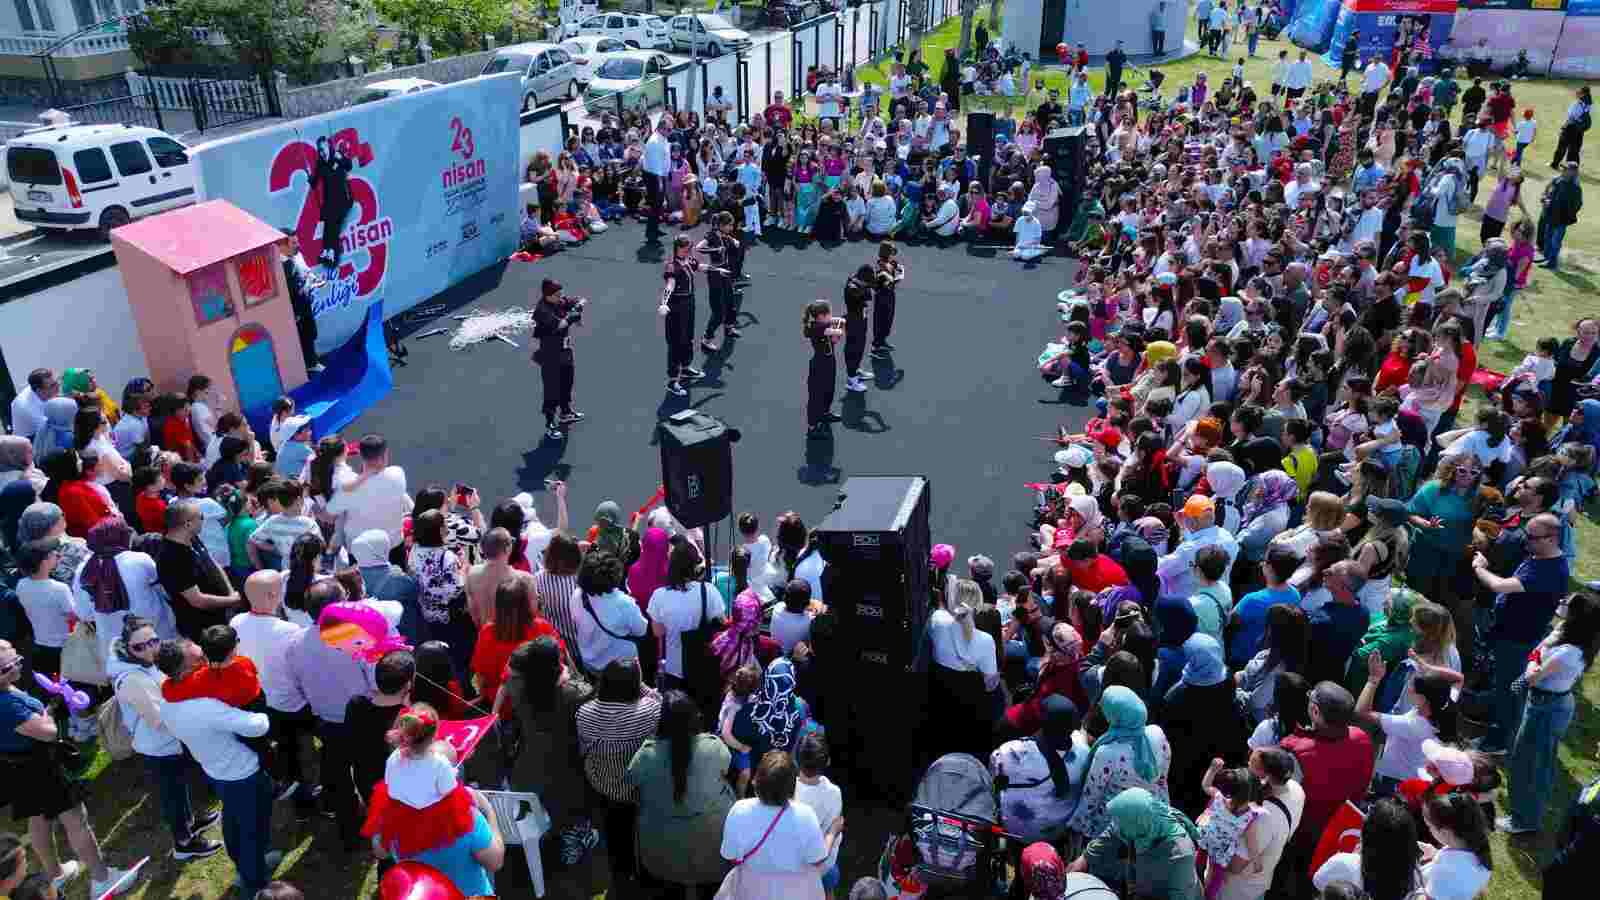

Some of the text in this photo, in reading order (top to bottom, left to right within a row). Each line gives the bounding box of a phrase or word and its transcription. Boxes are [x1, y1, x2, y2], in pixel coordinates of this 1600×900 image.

[449, 115, 474, 160] 23
[440, 158, 485, 189] nisan
[340, 217, 392, 255] nisan
